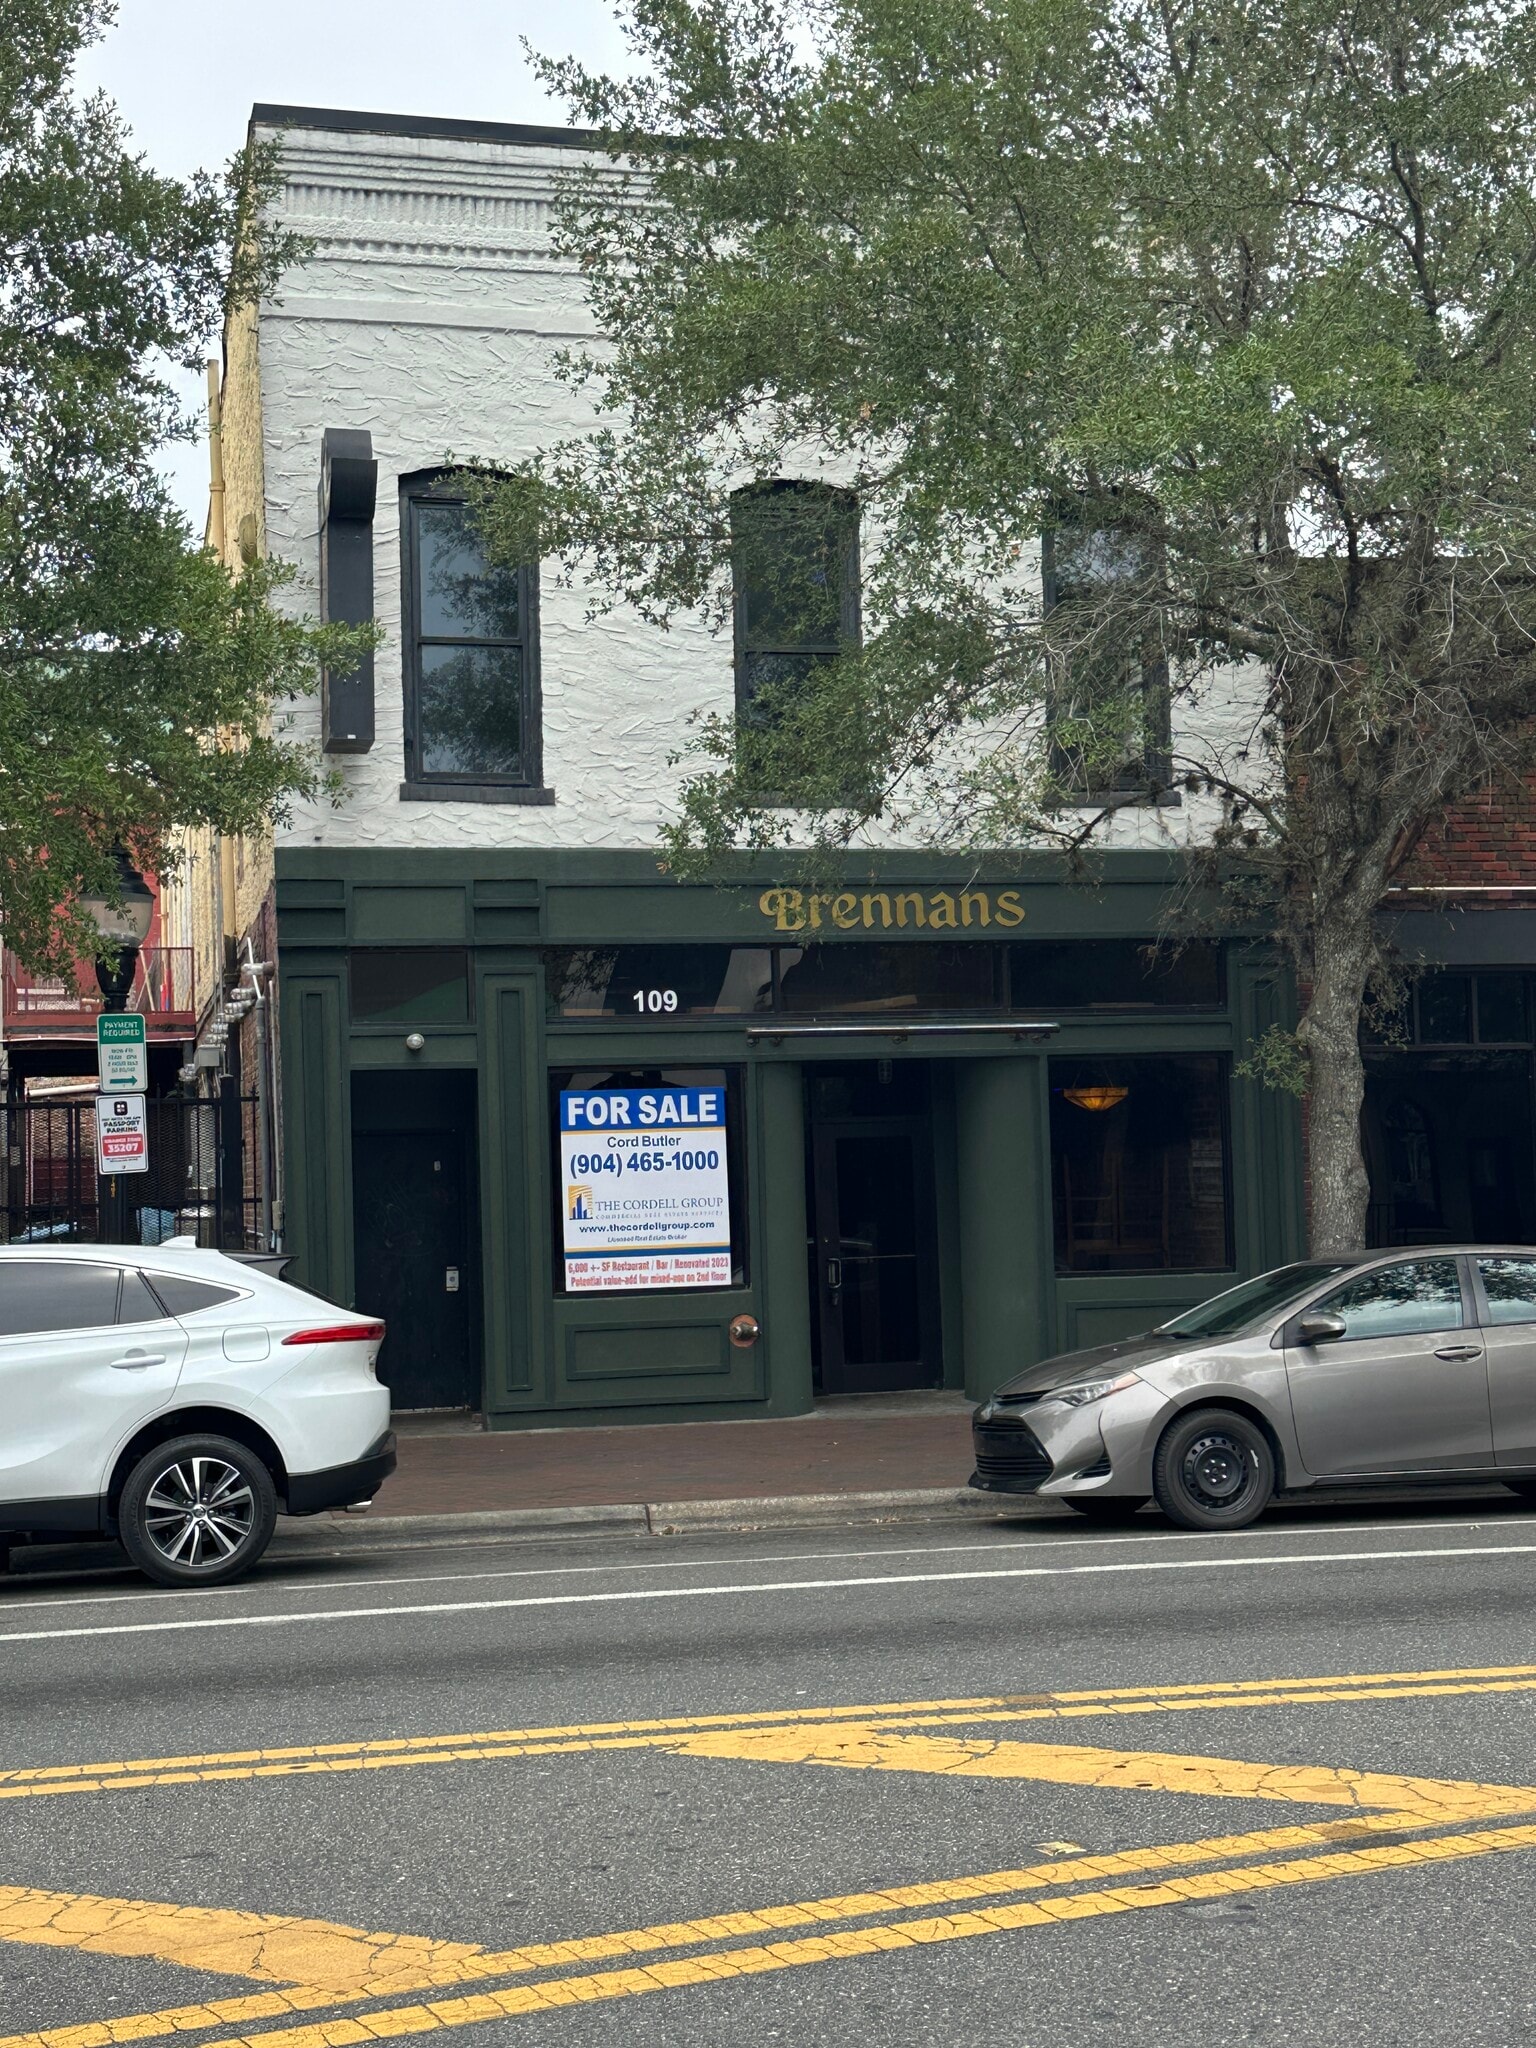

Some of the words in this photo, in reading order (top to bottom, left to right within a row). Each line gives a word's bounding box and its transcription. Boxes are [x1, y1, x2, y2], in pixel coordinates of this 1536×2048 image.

[758, 888, 1026, 931] Brennans
[633, 989, 678, 1013] 109
[104, 1021, 138, 1029] PAYMENT
[103, 1029, 140, 1037] REQUIRED
[567, 1096, 632, 1126] FOR
[638, 1094, 718, 1124] SALE
[107, 1143, 139, 1153] 35207
[607, 1136, 639, 1148] Cord
[642, 1135, 682, 1147] Butler
[570, 1153, 623, 1179] (904)
[626, 1150, 719, 1172] 465-1000
[595, 1200, 620, 1211] THE
[623, 1199, 679, 1210] CORDELL
[681, 1197, 723, 1208] GROUP
[579, 1220, 715, 1233] www.thecordellgroup.com
[601, 1261, 611, 1272] SF
[612, 1260, 649, 1271] Restaurant
[656, 1259, 668, 1270] Bar
[674, 1257, 710, 1269] Renovated
[711, 1256, 729, 1268] 2023
[570, 1275, 602, 1287] Potential
[603, 1274, 637, 1285] value-add
[639, 1273, 649, 1284] for
[650, 1272, 685, 1283] mixed-use
[686, 1274, 695, 1282] on
[696, 1271, 710, 1282] 2nd
[711, 1270, 727, 1281] floor
